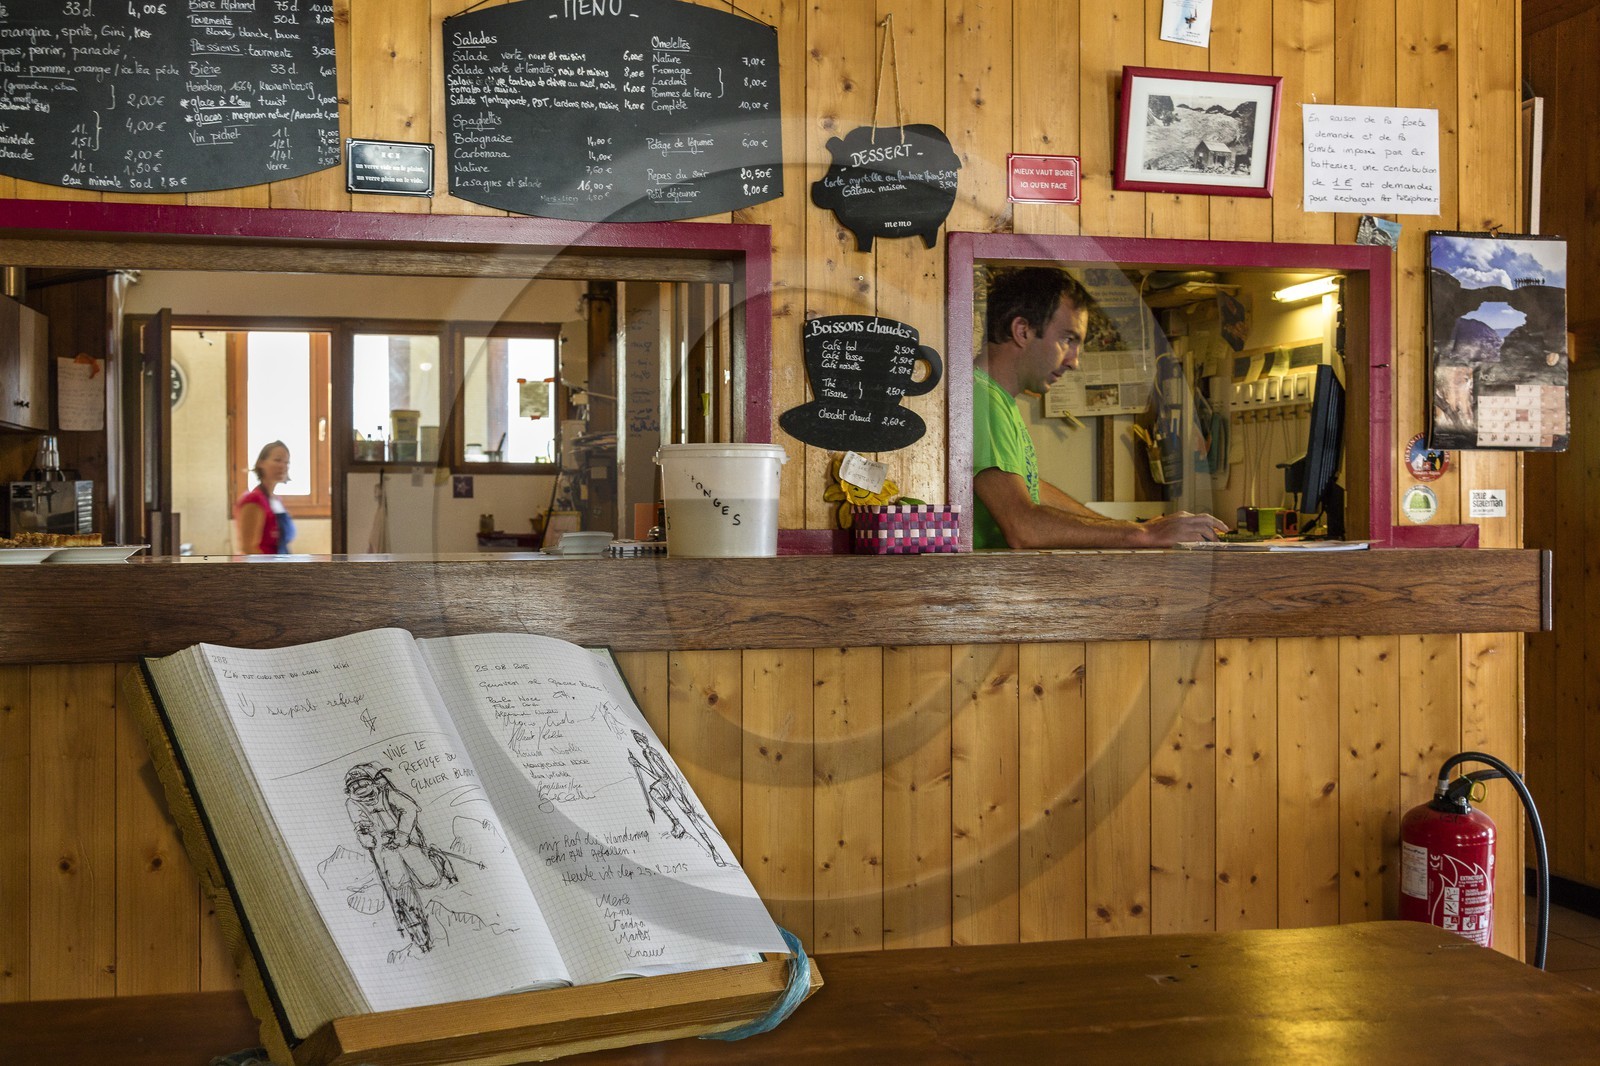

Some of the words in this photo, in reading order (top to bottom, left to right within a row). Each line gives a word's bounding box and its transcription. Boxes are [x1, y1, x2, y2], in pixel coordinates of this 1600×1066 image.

[128, 1, 167, 19] 4,00€
[452, 31, 498, 46] Salades
[651, 36, 691, 50] Omelettes
[452, 51, 490, 62] Salade
[652, 53, 682, 65] Nature
[74, 66, 111, 82] orange
[188, 60, 222, 76] Bière
[451, 63, 485, 75] Salade
[514, 62, 523, 73] et
[652, 65, 693, 81] Fromage
[652, 77, 687, 87] Lardons
[650, 86, 680, 98] Pommes
[682, 86, 692, 98] de
[693, 86, 712, 98] terre
[126, 117, 167, 135] 4,00€
[1364, 116, 1376, 124] de
[189, 130, 205, 144] Vin
[453, 133, 513, 149] Bolognaise
[1315, 131, 1355, 139] demande
[1362, 132, 1373, 140] et
[674, 137, 685, 148] de
[454, 148, 511, 159] Carbonara
[850, 144, 912, 168] DESSERT
[454, 164, 490, 173] Nature
[676, 169, 688, 179] du
[1362, 164, 1379, 172] une
[455, 176, 502, 192] Lasagnes
[506, 177, 516, 188] et
[884, 220, 912, 228] memo
[812, 319, 864, 336] Boissons
[867, 317, 912, 338] chaudes
[822, 339, 842, 350] Café
[845, 341, 857, 351] bol
[821, 351, 840, 361] Café
[821, 359, 838, 369] Café
[822, 377, 837, 388] Thé
[822, 389, 848, 399] Tisane
[818, 408, 847, 421] Chocolat
[849, 412, 871, 423] chaud
[415, 740, 426, 750] LE
[399, 754, 440, 775] REFUGE
[411, 773, 449, 794] GLACIER
